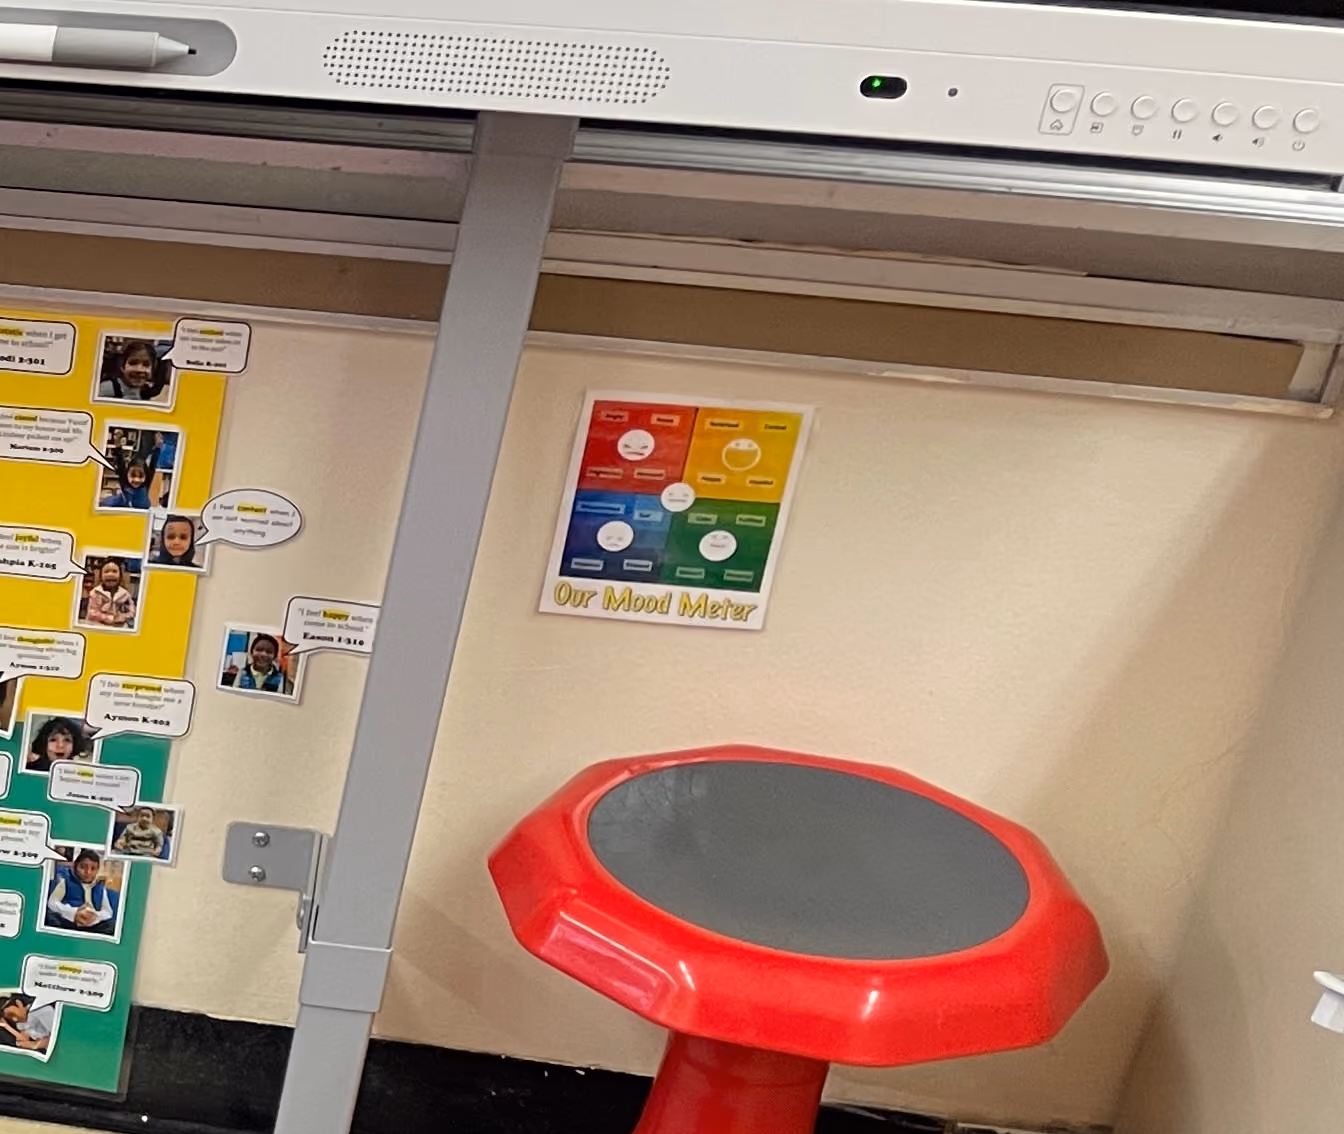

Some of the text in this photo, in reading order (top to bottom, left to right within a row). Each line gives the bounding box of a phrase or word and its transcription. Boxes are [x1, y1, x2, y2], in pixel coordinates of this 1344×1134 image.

[554, 580, 759, 622] Our Mood Meter
